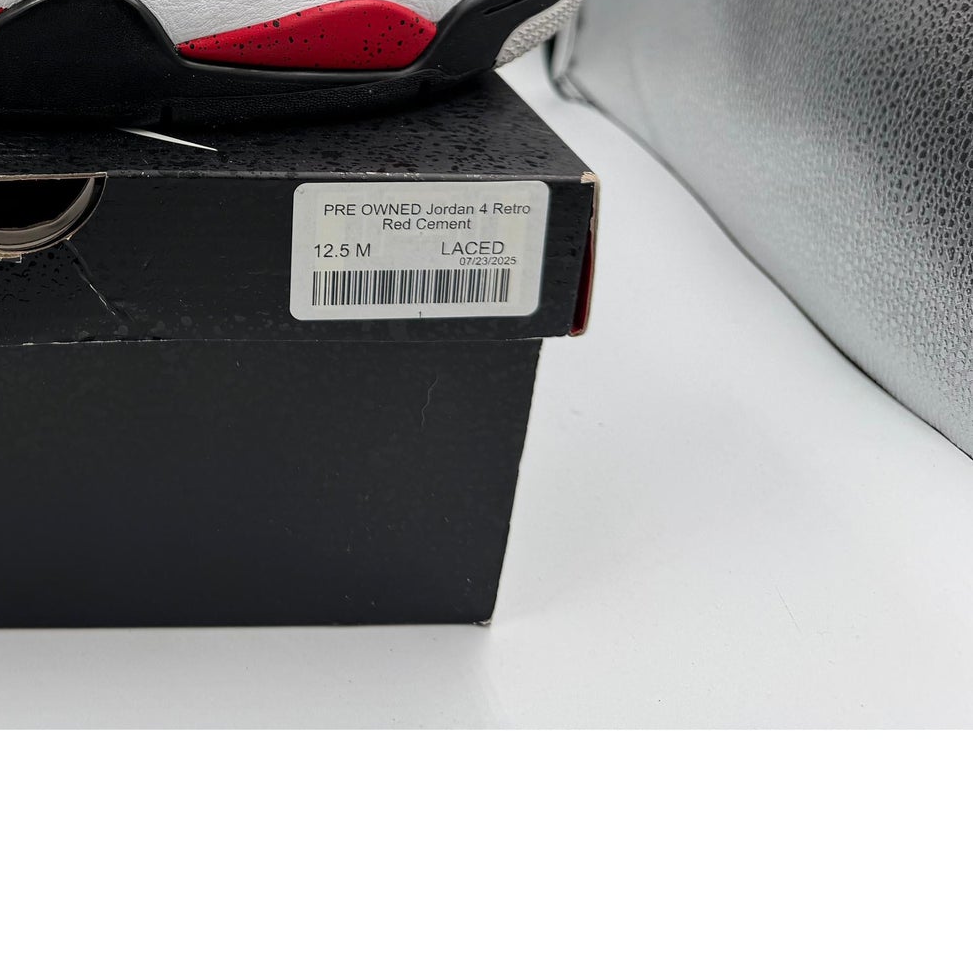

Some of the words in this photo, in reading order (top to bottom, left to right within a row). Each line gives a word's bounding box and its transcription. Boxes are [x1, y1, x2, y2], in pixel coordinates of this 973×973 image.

[323, 204, 356, 216] PRE
[361, 203, 422, 216] OWNED
[426, 202, 474, 216] Jordan
[479, 203, 488, 215] 4
[492, 202, 531, 215] Retro
[382, 217, 411, 230] Red
[416, 217, 472, 230] Cement
[313, 243, 350, 258] 12.5
[355, 243, 371, 257] M
[441, 241, 505, 256] LACED
[459, 256, 517, 266] 07/23/2025
